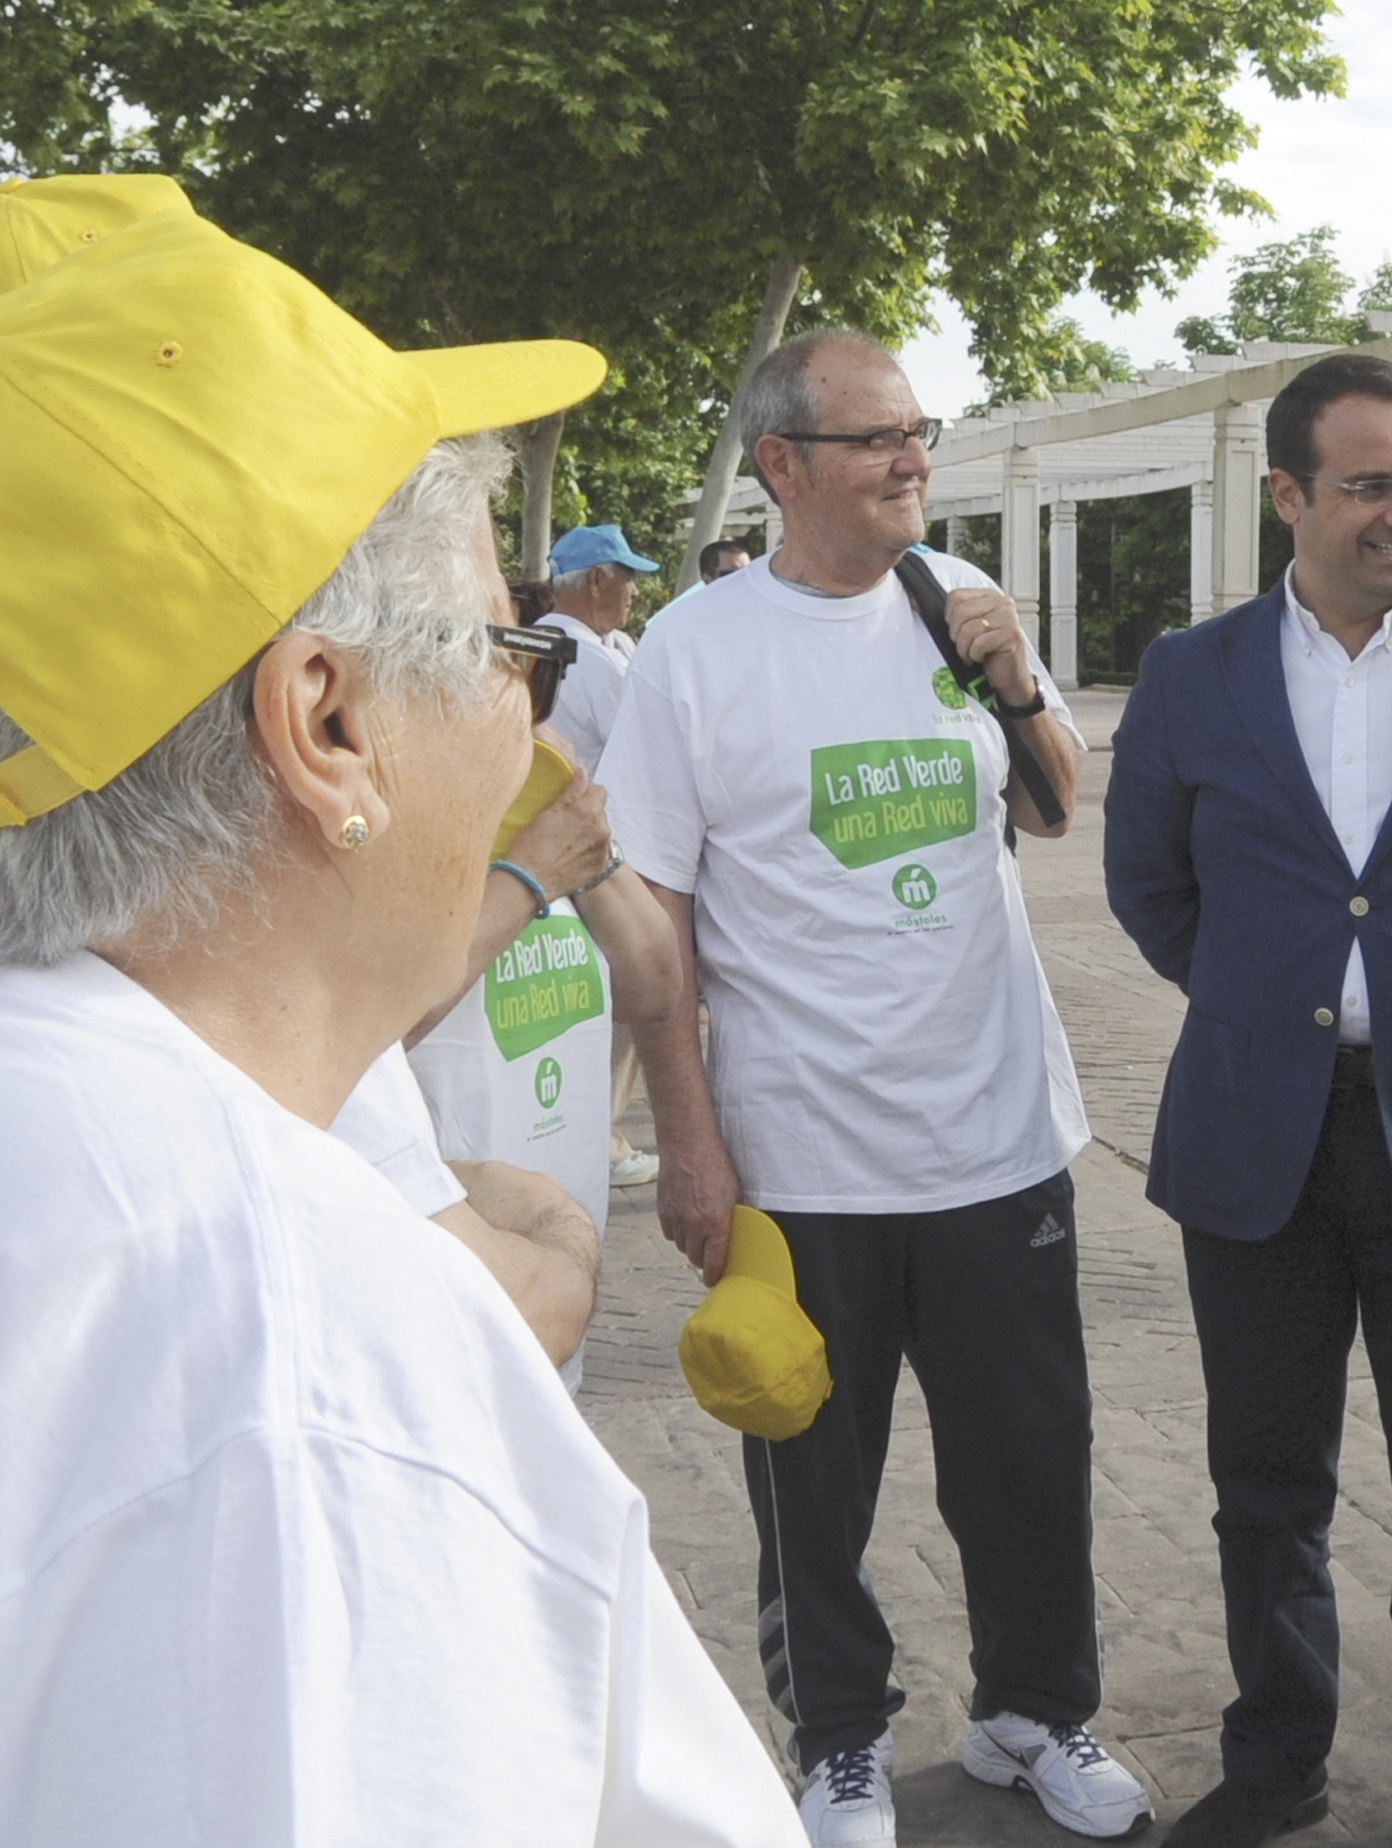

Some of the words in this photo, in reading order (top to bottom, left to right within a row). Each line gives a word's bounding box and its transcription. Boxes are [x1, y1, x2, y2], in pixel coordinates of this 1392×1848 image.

[825, 772, 855, 806] La
[857, 758, 899, 798] Red
[902, 751, 964, 789] Verde
[834, 808, 877, 843] una
[882, 795, 925, 836] Red
[929, 792, 968, 826] viva
[495, 949, 515, 983] La
[514, 934, 542, 978] Red
[543, 928, 589, 970] Verde
[496, 997, 529, 1029] una
[529, 978, 559, 1021] Red
[562, 975, 590, 1012] viva
